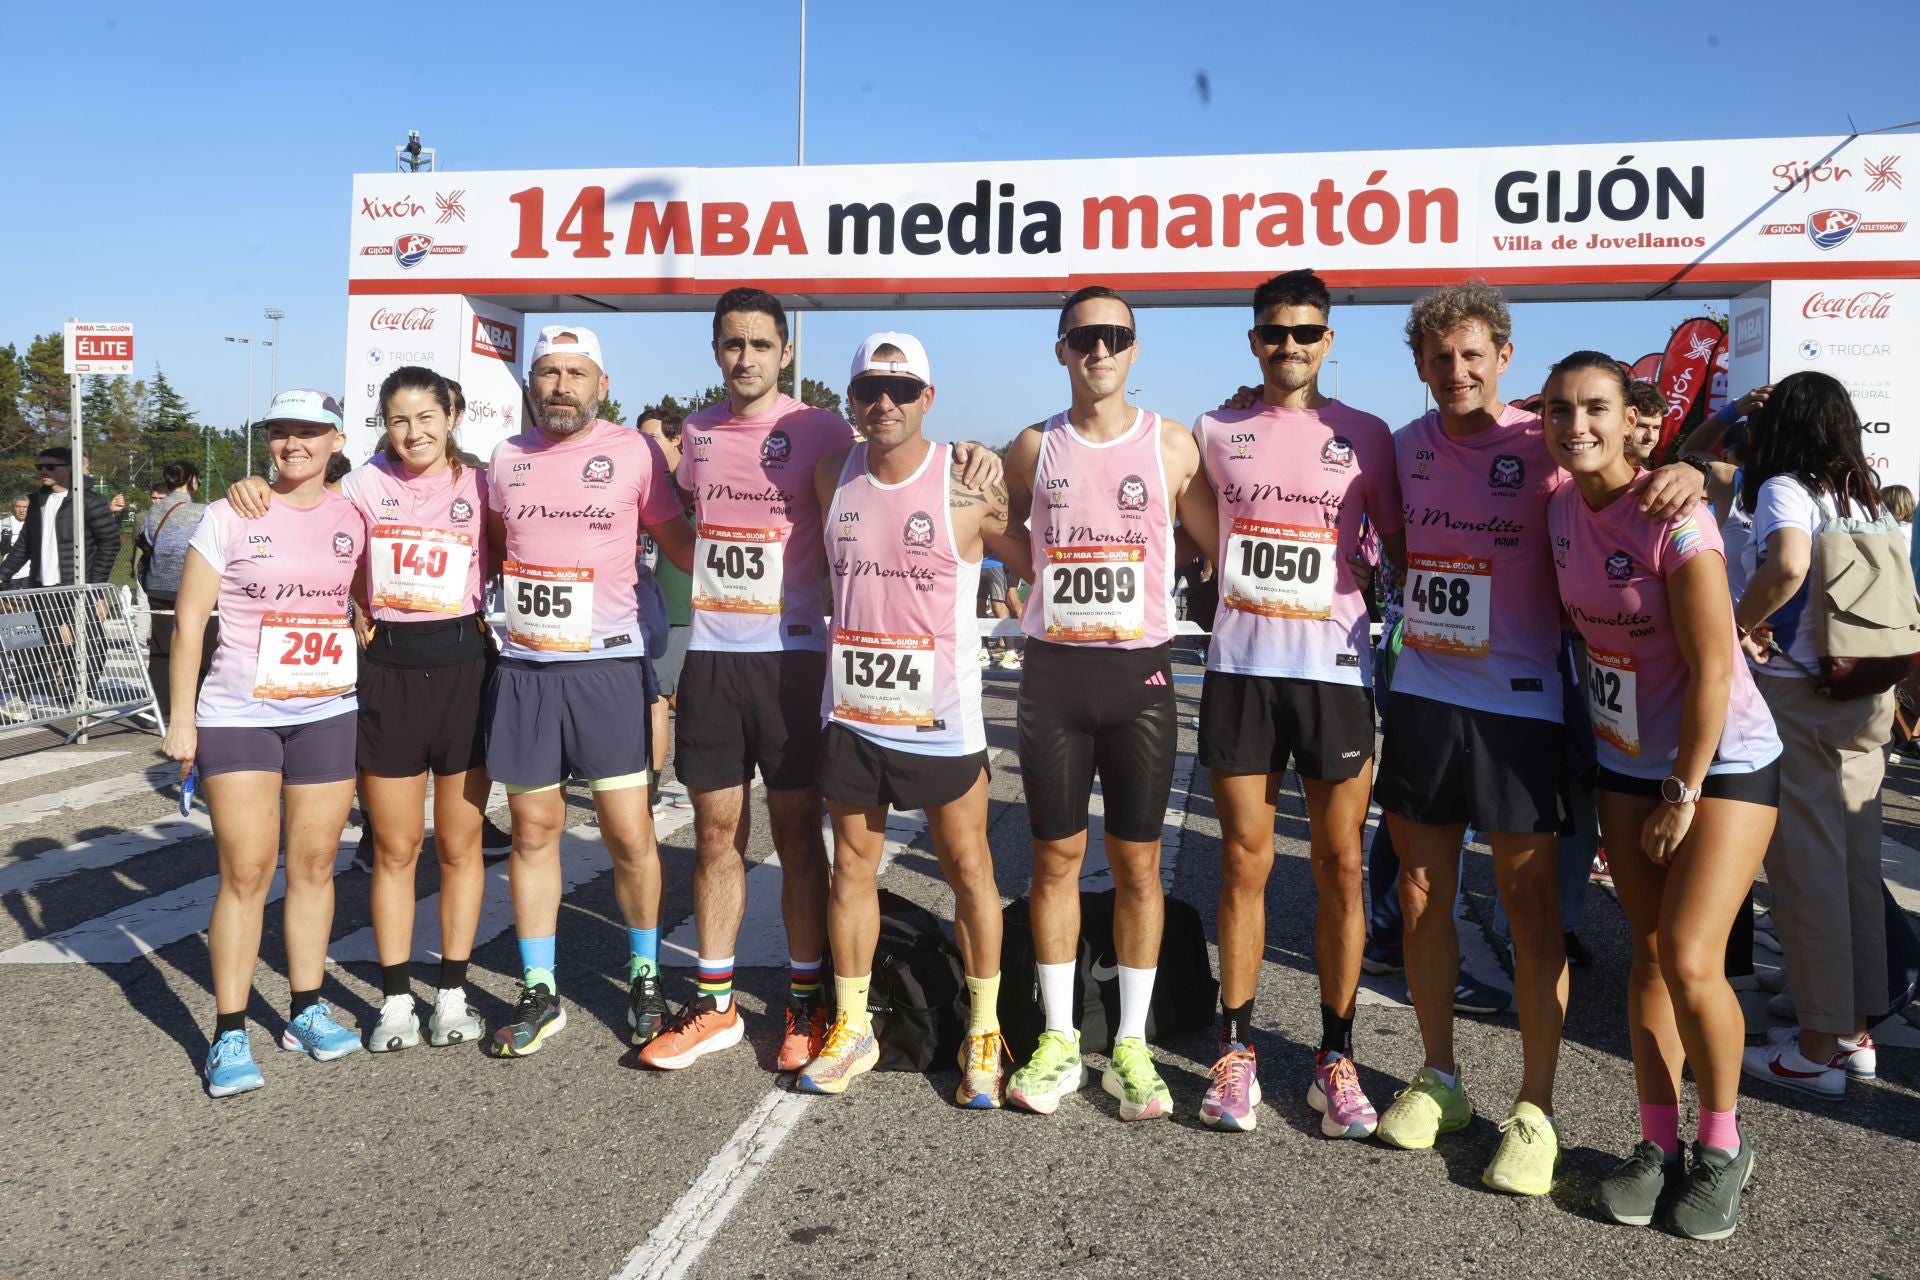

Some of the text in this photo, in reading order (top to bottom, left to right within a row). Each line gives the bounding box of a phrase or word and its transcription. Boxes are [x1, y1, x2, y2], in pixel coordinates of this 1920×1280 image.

[1772, 158, 1852, 193] gijón
[1494, 155, 1706, 225] GIJÓN
[509, 169, 1459, 259] 14 MBA media maratón
[1771, 222, 1899, 234] GIJÓN ATLETISMO
[368, 246, 461, 255] GIJÓN ATLETISMO
[1492, 231, 1706, 253] Villa de Jovellanos
[475, 321, 512, 350] MBA
[1738, 314, 1763, 343] MBA
[79, 337, 128, 356] ÉLITE
[389, 351, 435, 362] TRIOCAR
[1827, 344, 1891, 356] TRIOCAR
[706, 483, 795, 502] Monolito
[1223, 482, 1345, 511] El Monolito
[517, 503, 616, 520] Monolito
[1421, 507, 1525, 533] Monolito
[716, 530, 732, 538] MBA
[746, 532, 766, 540] GIJÓN
[1068, 526, 1149, 545] Monolito
[1260, 526, 1281, 535] MBA
[1298, 530, 1321, 539] GIJÓN
[390, 542, 449, 579] 140
[706, 543, 765, 580] 403
[1073, 551, 1093, 559] MBA
[1240, 540, 1322, 585] 1050
[527, 569, 542, 577] MBA
[834, 558, 936, 580] El Monolito
[241, 582, 267, 599] El
[1053, 566, 1136, 605] 2099
[1255, 585, 1278, 593] MARCOS
[1412, 574, 1470, 617] 468
[517, 581, 573, 619] 565
[1444, 622, 1476, 631] RODRÍGUEZ
[280, 631, 343, 666] 294
[861, 636, 880, 645] MBA
[896, 638, 918, 646] GIJÓN
[842, 649, 921, 691] 1324
[292, 1024, 321, 1044] BROOKS
